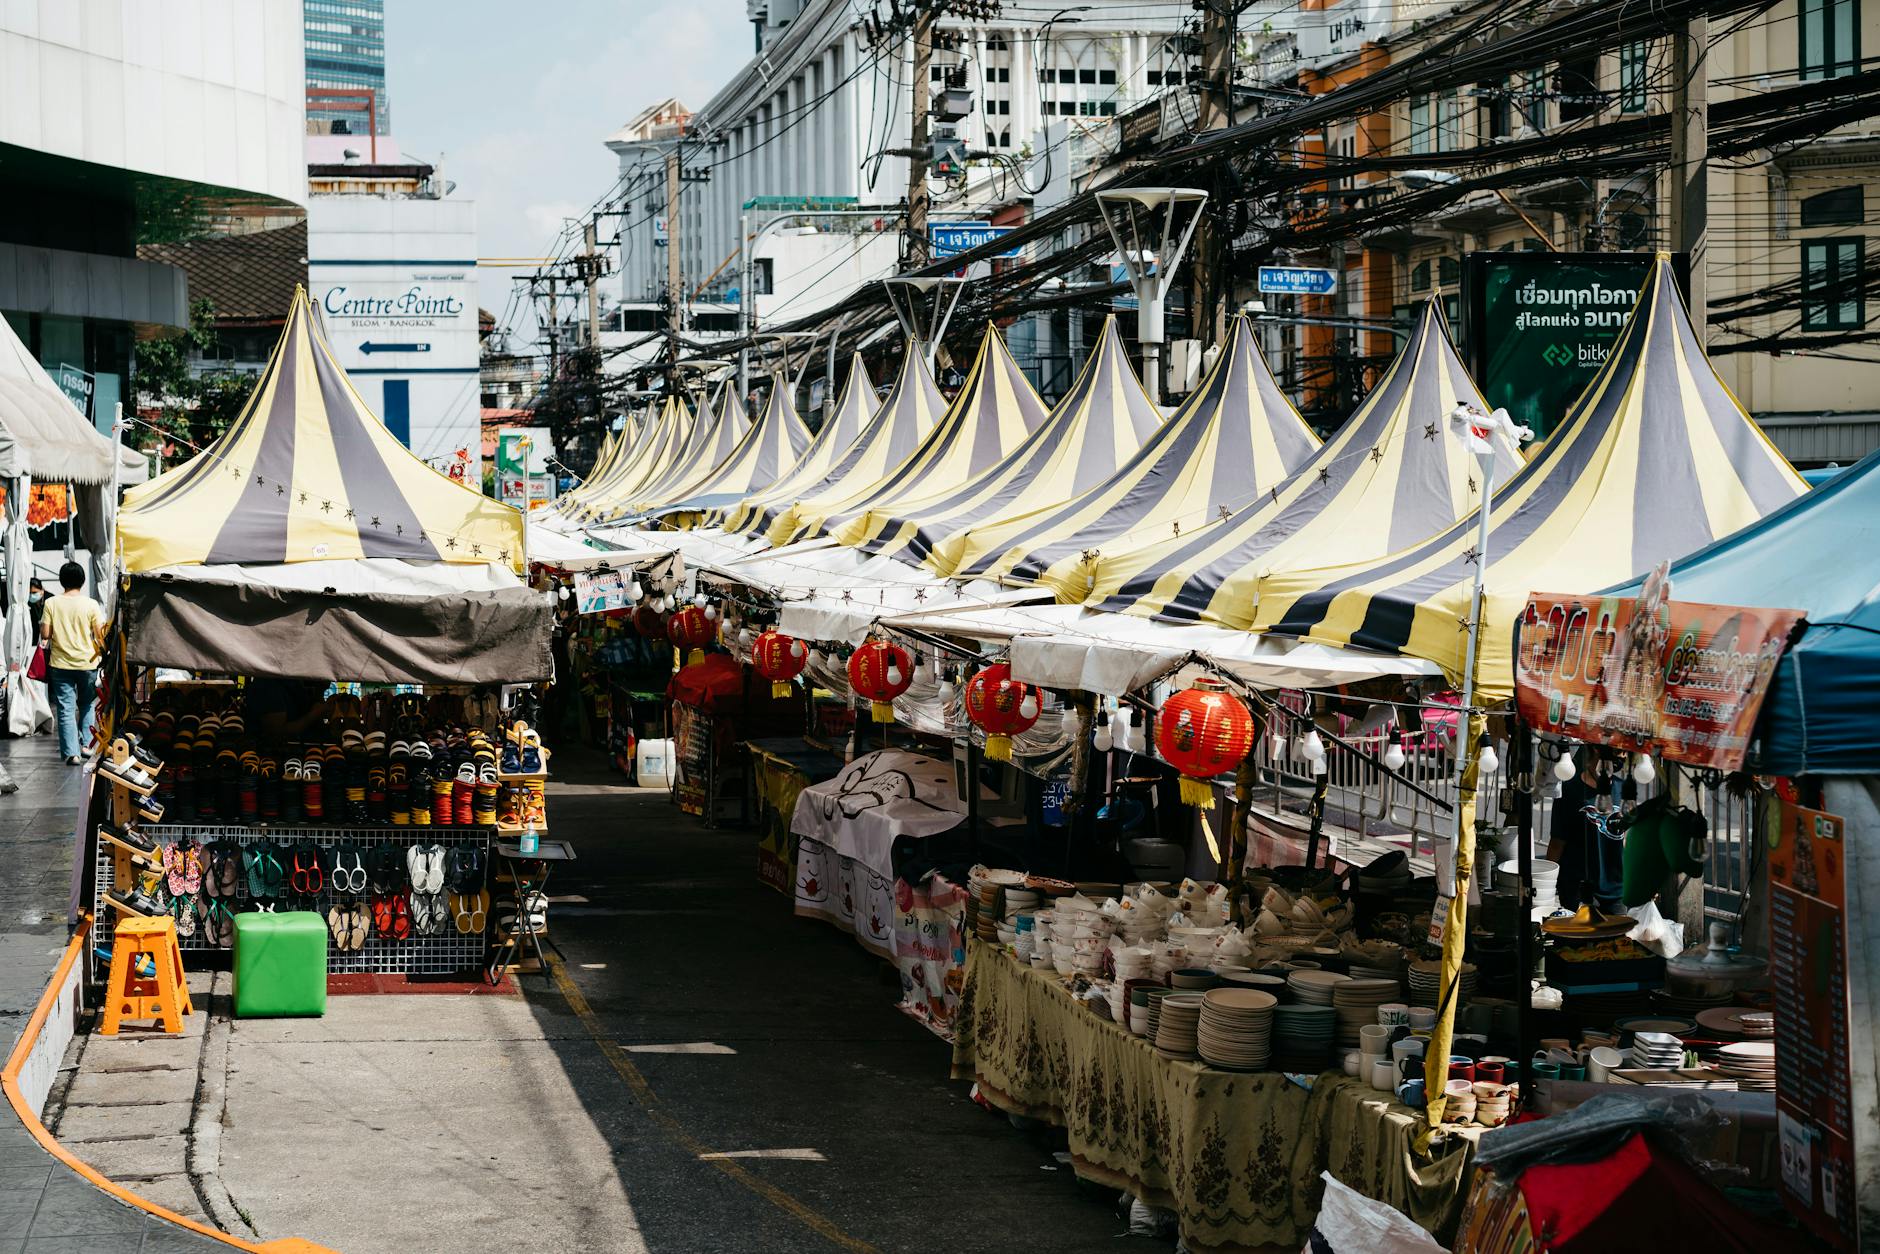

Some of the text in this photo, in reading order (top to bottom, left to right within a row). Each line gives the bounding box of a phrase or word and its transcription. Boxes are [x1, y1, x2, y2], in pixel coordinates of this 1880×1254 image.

[1330, 21, 1342, 43] LH
[325, 286, 463, 314] Centre Point
[1515, 279, 1641, 310] เชื่อมทุกโอกา
[1515, 311, 1579, 331] สู่โลกแห่ง
